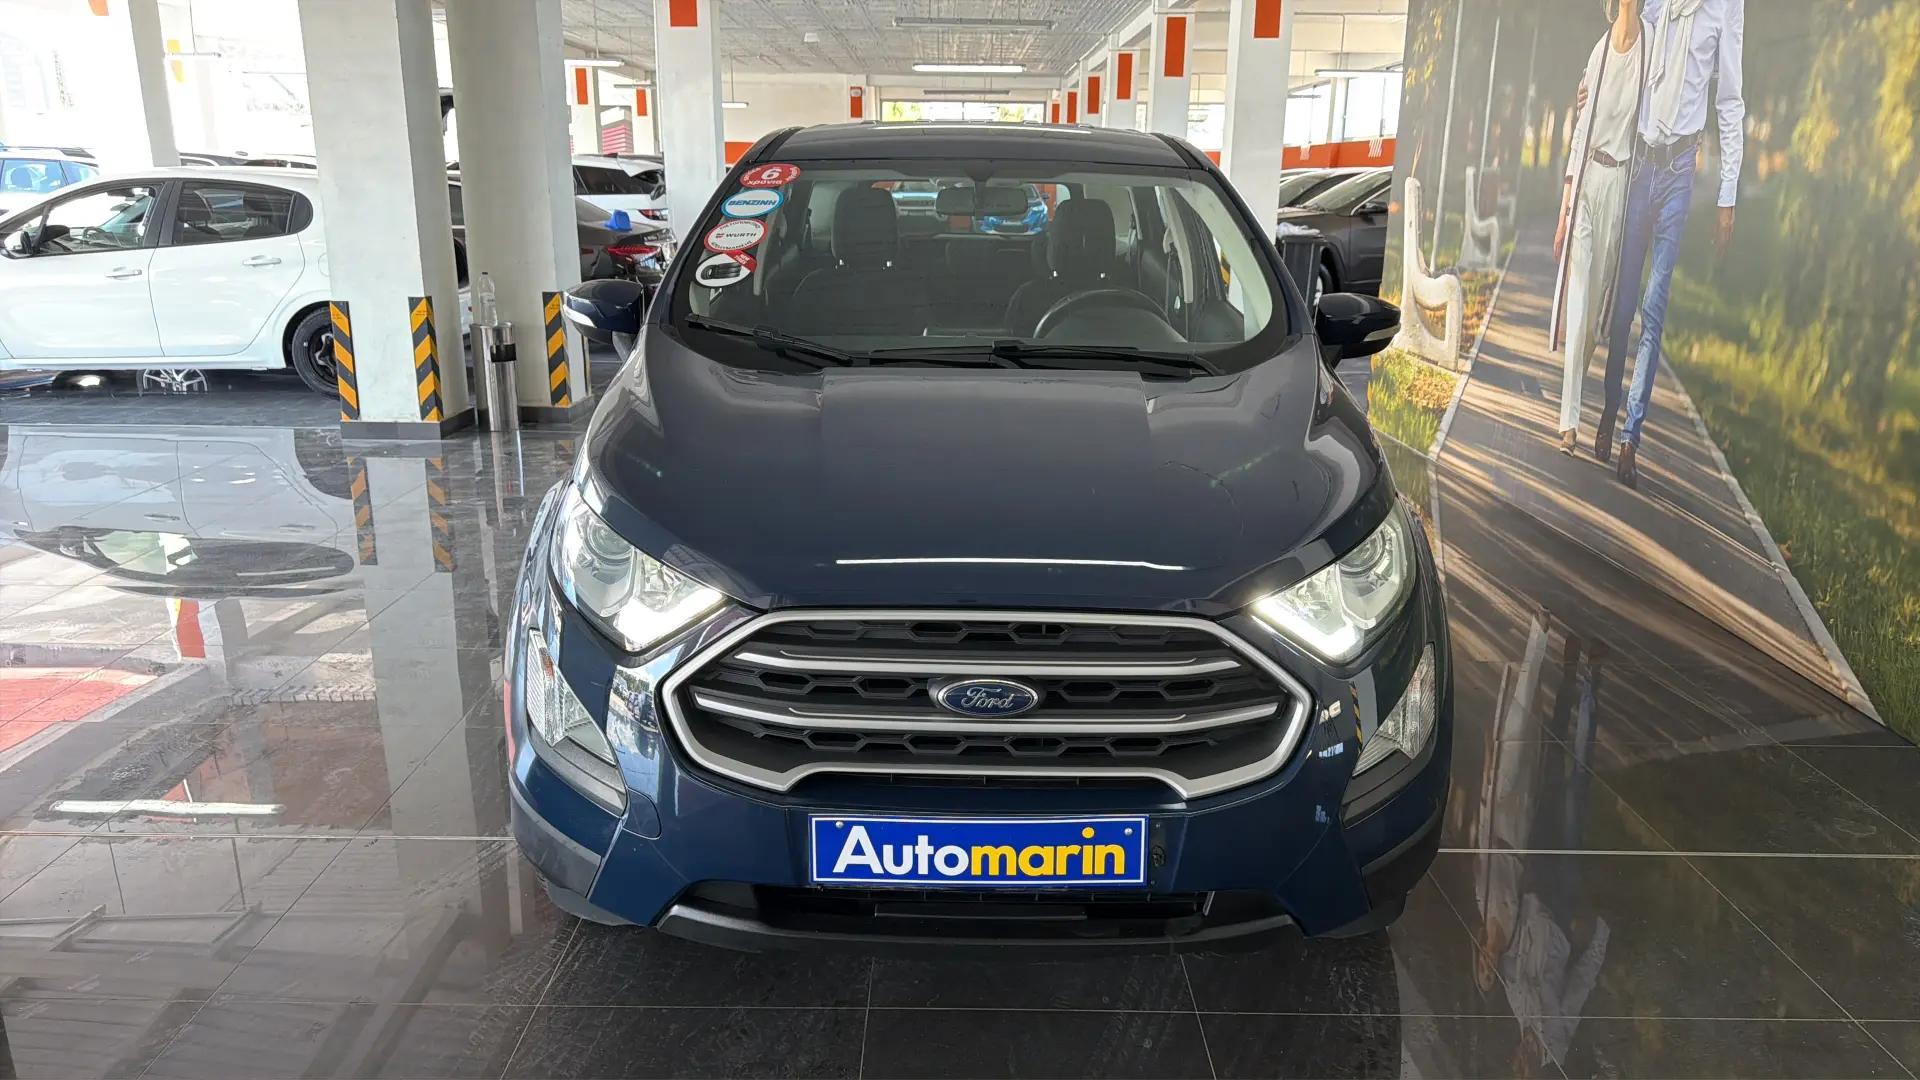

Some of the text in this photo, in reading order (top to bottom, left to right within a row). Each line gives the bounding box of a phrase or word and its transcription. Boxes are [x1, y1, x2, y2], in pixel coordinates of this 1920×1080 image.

[761, 168, 783, 180] 6
[960, 686, 1015, 709] Ford
[832, 825, 1126, 877] Automarin
